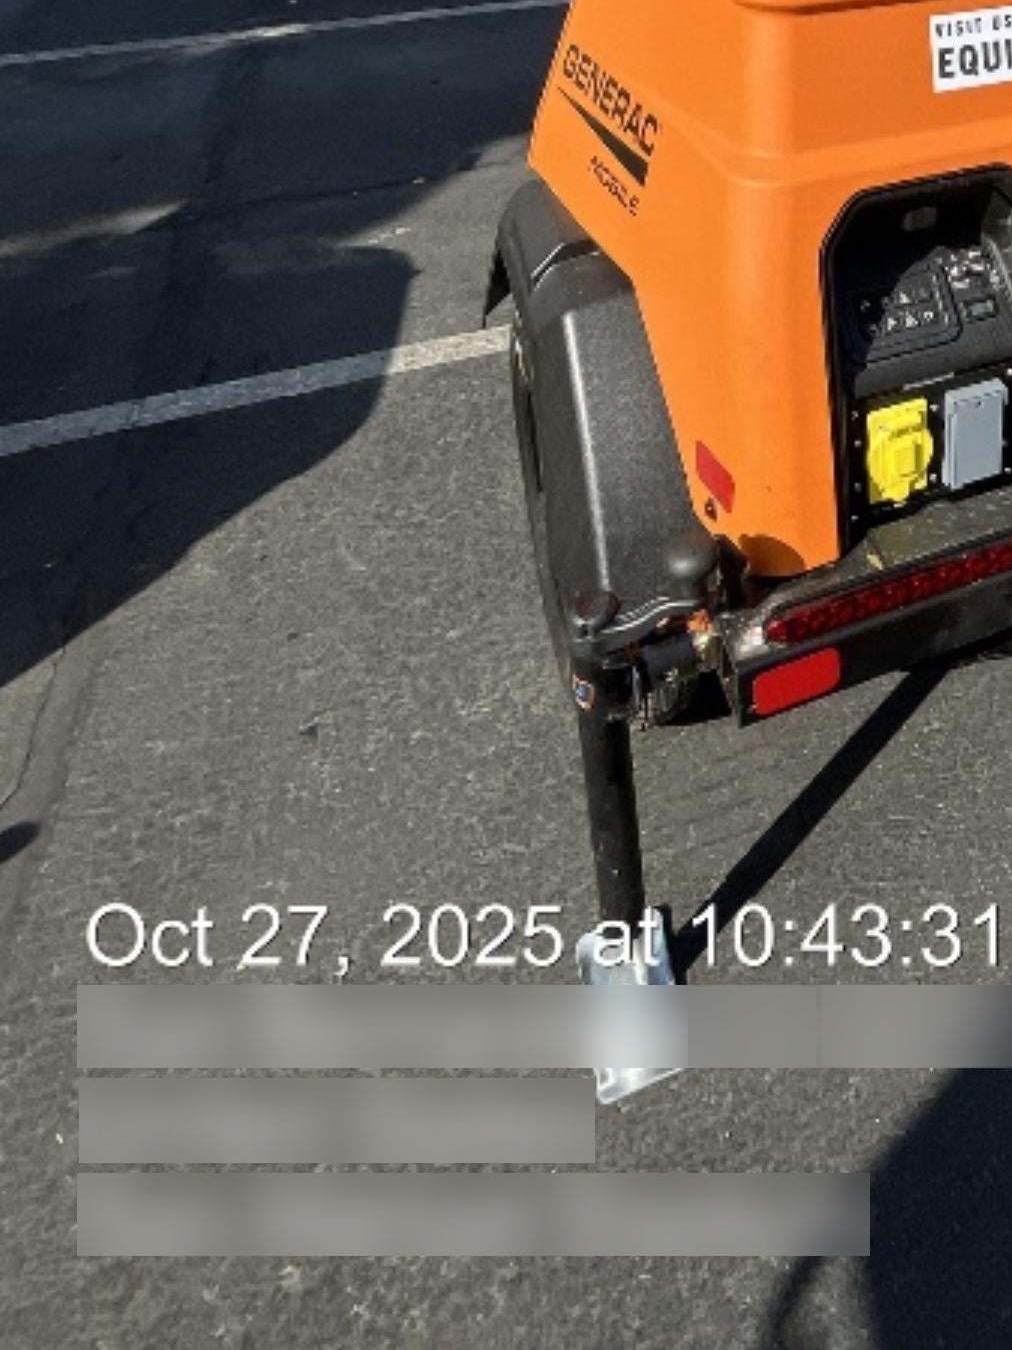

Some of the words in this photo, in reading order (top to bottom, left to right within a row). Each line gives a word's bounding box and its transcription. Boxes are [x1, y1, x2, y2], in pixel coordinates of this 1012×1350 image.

[935, 16, 982, 38] VISIT
[992, 14, 1012, 31] US
[562, 43, 658, 157] GENERAC
